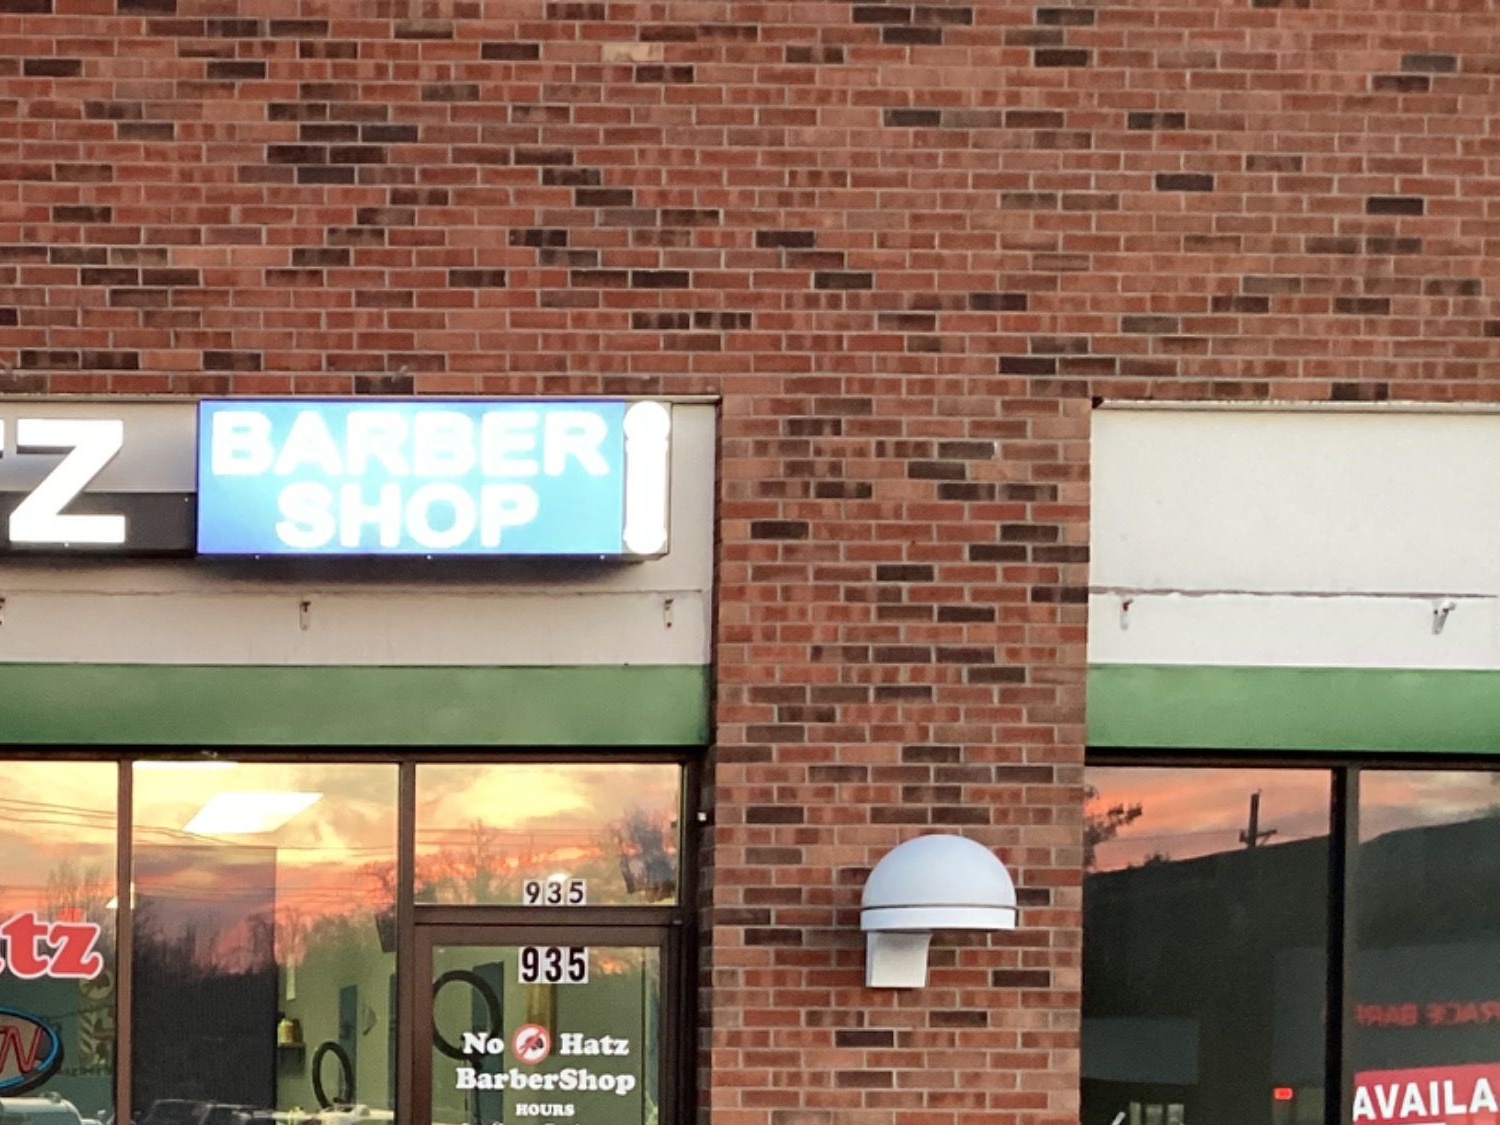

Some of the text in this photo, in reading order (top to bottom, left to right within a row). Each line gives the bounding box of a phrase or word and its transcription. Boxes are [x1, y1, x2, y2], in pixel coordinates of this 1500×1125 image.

[211, 410, 610, 477] BARBER
[276, 482, 539, 549] SHOP
[525, 881, 583, 904] 935
[521, 946, 586, 982] 935
[463, 1031, 630, 1055] No Hatz
[455, 1067, 636, 1095] BarberShop
[515, 1102, 575, 1117] HOURS
[1353, 1078, 1499, 1121] AVAILA
